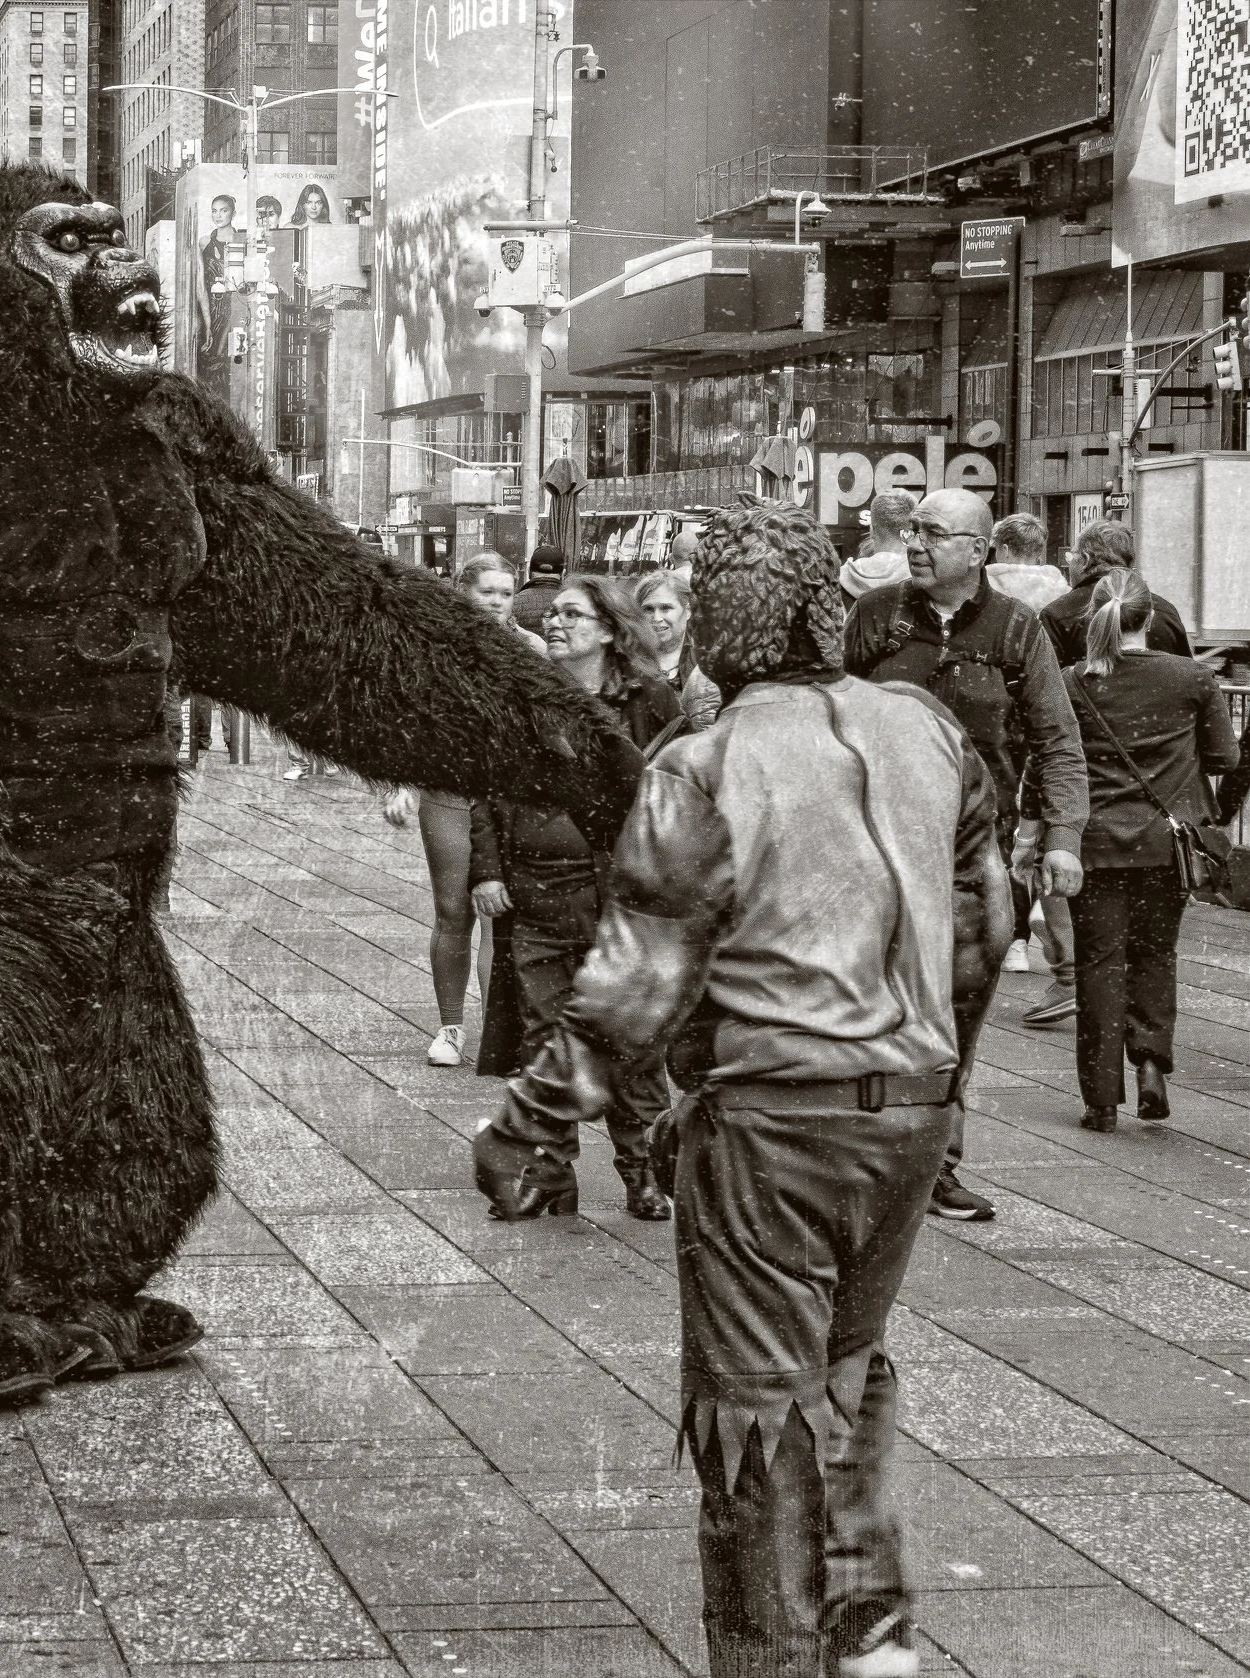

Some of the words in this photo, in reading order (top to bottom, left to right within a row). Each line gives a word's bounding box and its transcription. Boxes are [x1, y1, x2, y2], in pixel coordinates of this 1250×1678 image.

[965, 227, 976, 238] NO
[977, 224, 1013, 239] STOPPING
[965, 240, 995, 252] Anytime
